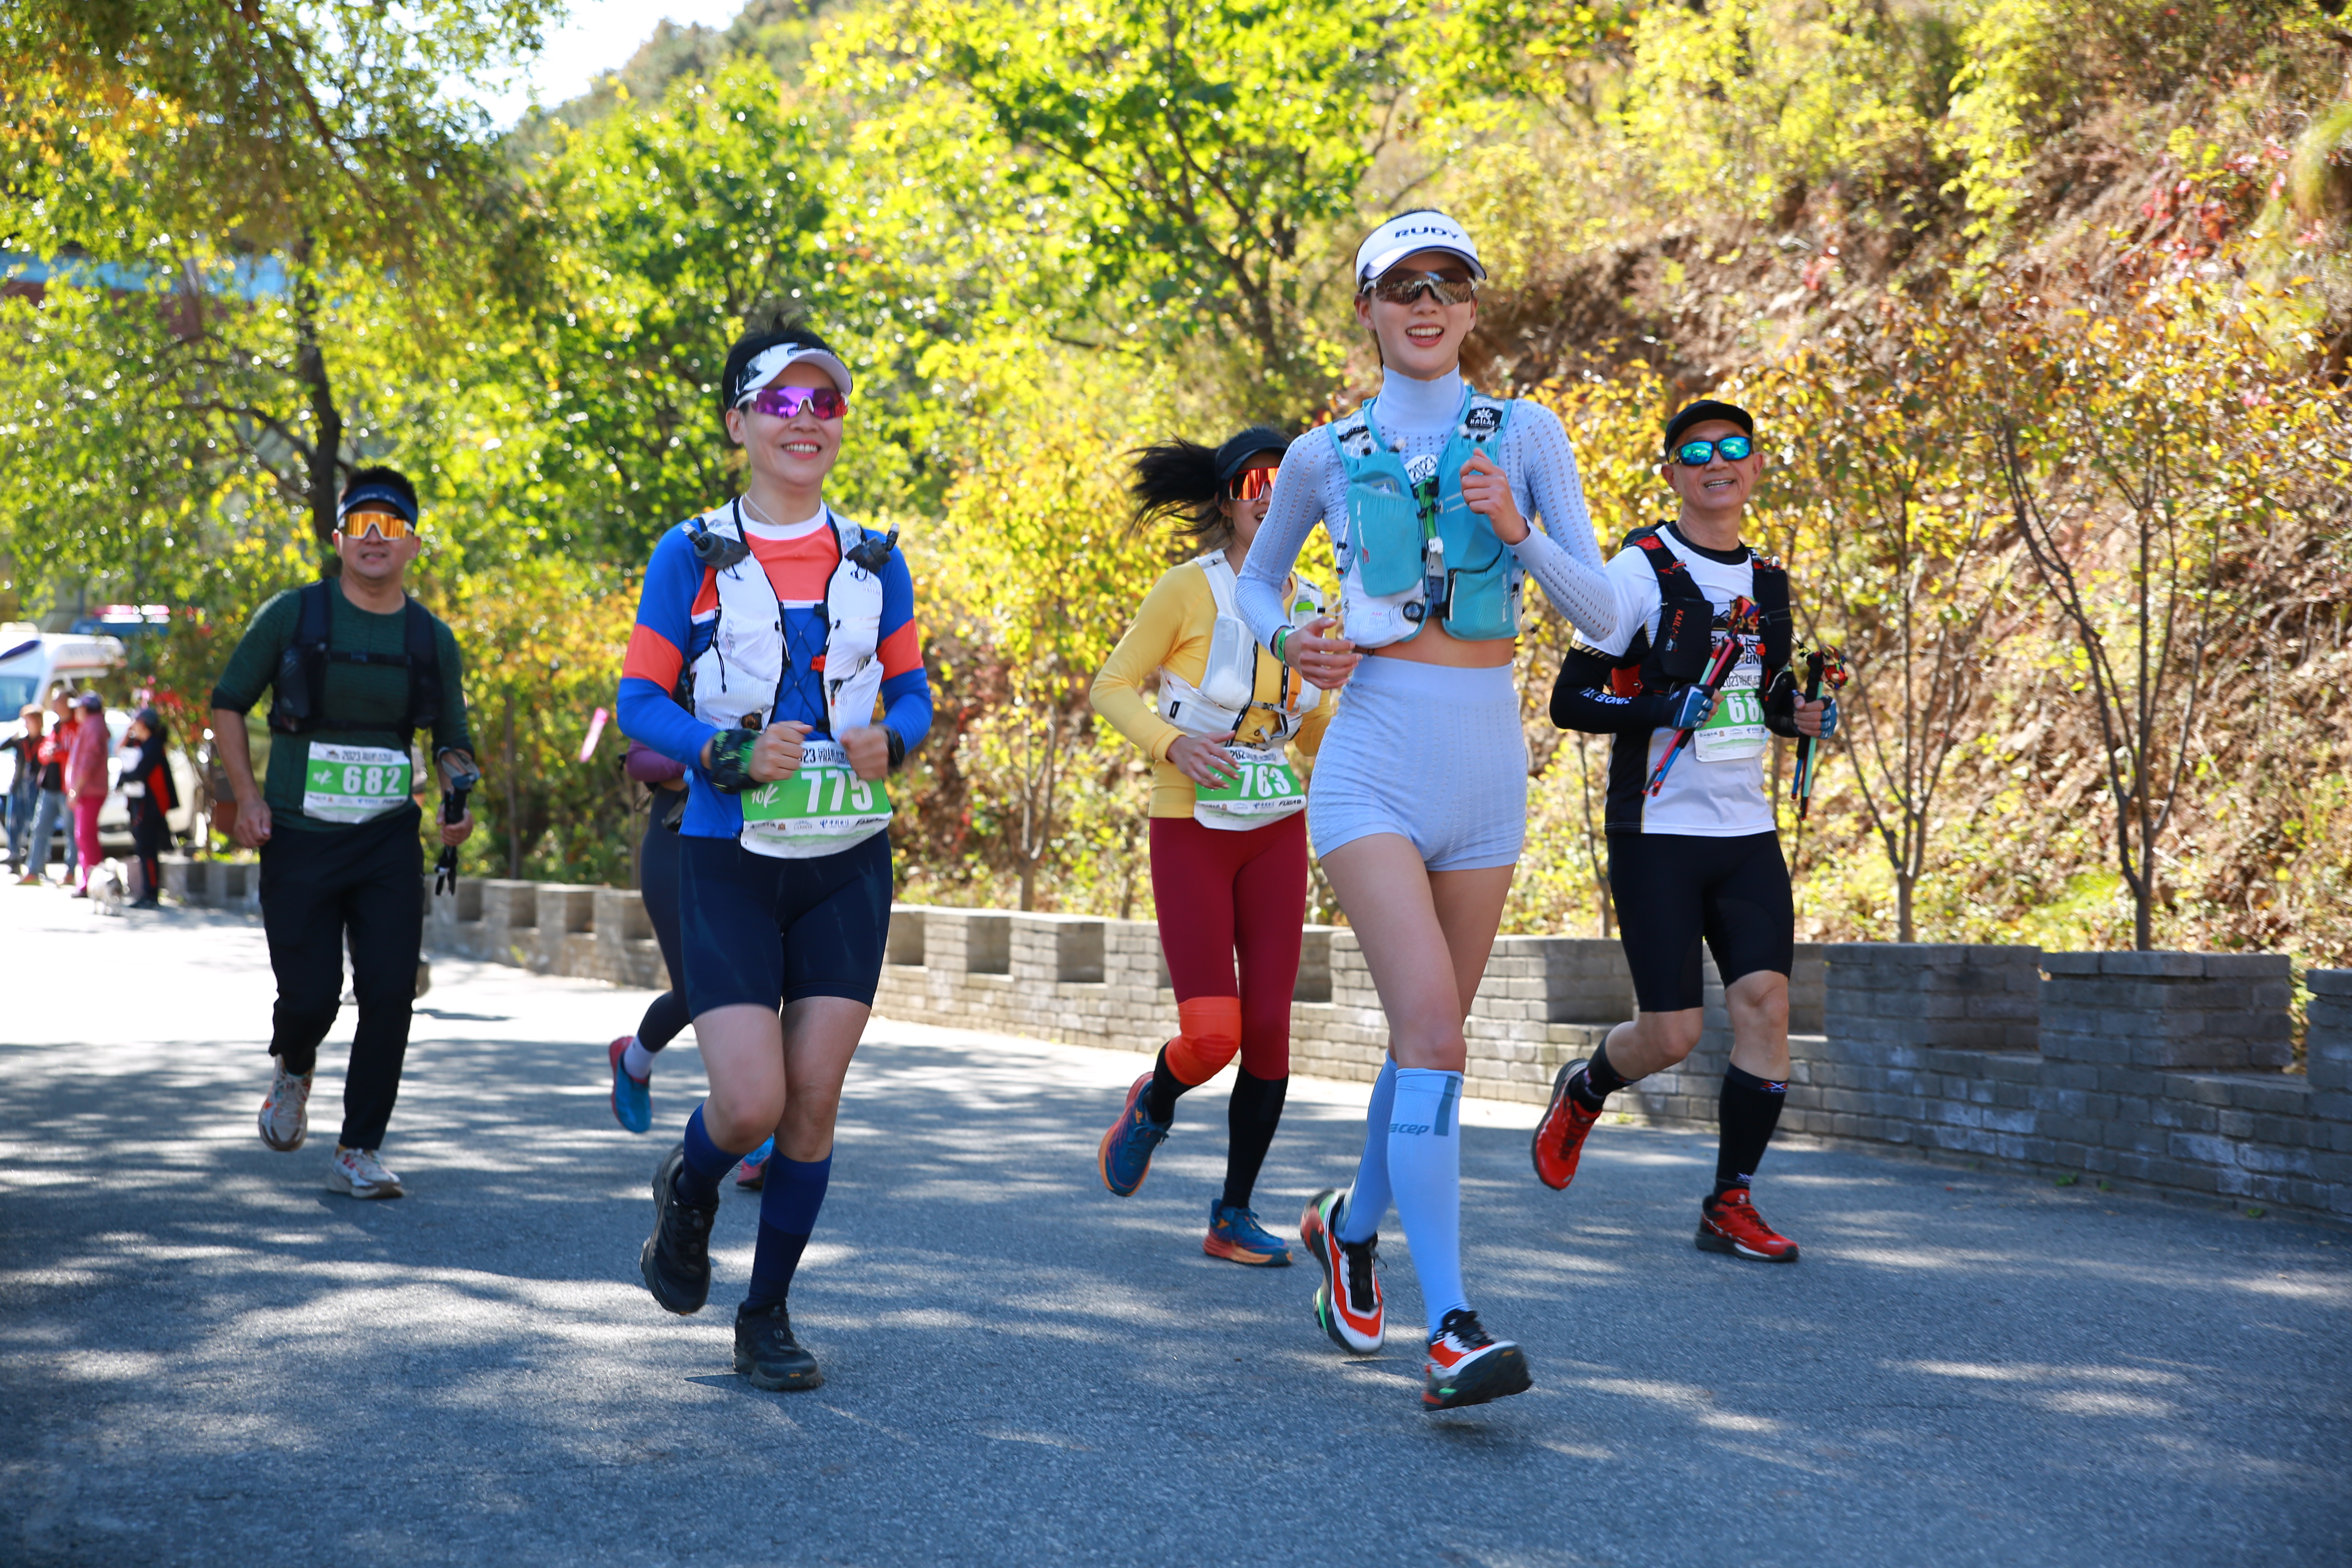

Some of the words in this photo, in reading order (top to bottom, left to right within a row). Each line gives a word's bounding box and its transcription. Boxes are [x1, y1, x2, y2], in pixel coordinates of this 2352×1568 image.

[1394, 226, 1459, 240] RUDY
[1408, 454, 1437, 482] 2023
[1726, 691, 1765, 724] 68
[342, 751, 361, 762] 2023
[343, 766, 401, 794] 682
[751, 784, 780, 808] 10K
[801, 769, 873, 813] 775
[1238, 765, 1291, 798] 763
[1398, 1124, 1430, 1135] cep
